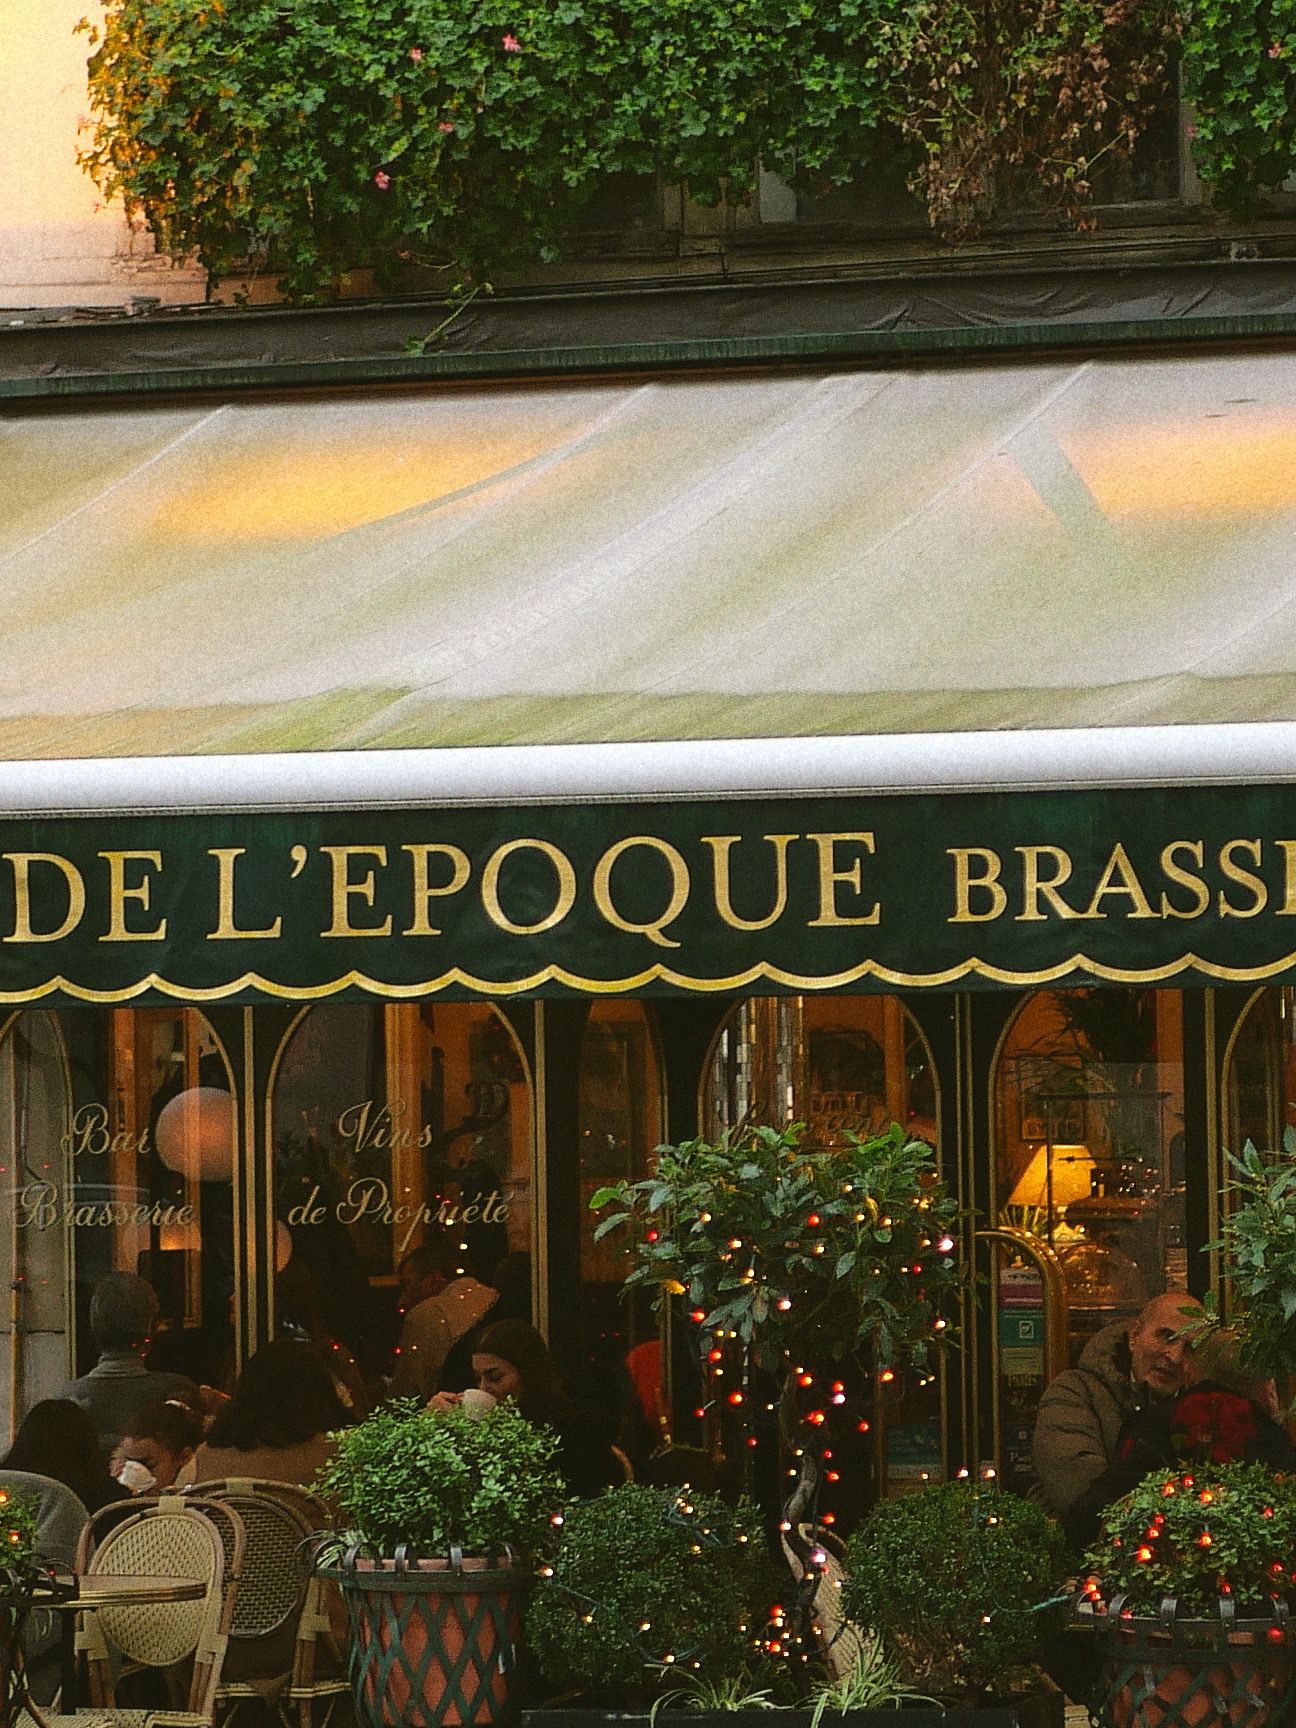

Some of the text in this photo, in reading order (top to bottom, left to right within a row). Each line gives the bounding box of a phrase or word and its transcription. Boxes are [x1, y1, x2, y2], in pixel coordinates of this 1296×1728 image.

[1, 849, 169, 944] DE
[205, 830, 883, 949] L'EPOQUE
[60, 1102, 152, 1156] Bar
[337, 1100, 433, 1153] Vins
[15, 1180, 194, 1229] Brasserie
[287, 1176, 516, 1252] de Propriété
